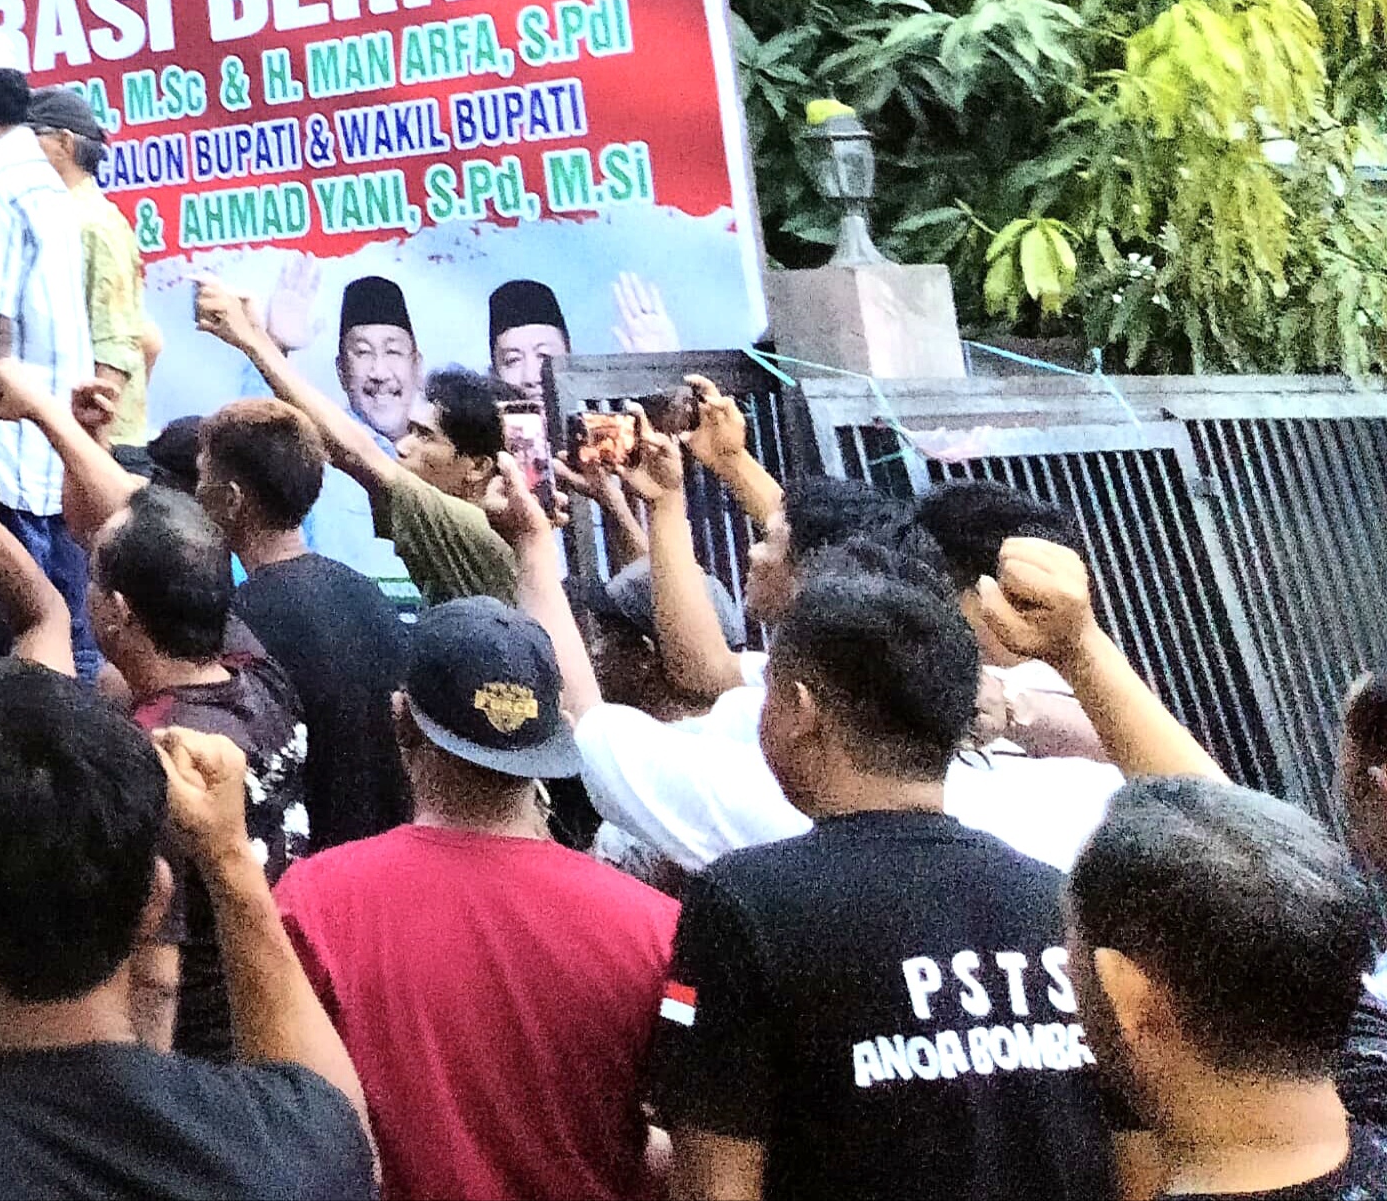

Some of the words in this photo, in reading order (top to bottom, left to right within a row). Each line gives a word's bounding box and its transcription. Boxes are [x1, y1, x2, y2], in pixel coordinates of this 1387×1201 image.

[124, 67, 206, 124] M.Sc
[222, 57, 249, 108] &
[264, 50, 302, 104] H.
[308, 33, 392, 97] MAN
[403, 16, 513, 84] ARFA,
[192, 118, 299, 180] BUPATI
[308, 114, 333, 163] &
[337, 101, 449, 158] WAKIL
[453, 80, 586, 146] BUPATI
[137, 201, 163, 250] &
[181, 184, 307, 246] AHMAD
[316, 173, 420, 233] YANI,
[426, 159, 539, 221] S.Pd,
[546, 143, 653, 208] M.Si
[853, 1028, 970, 1088] ANOA
